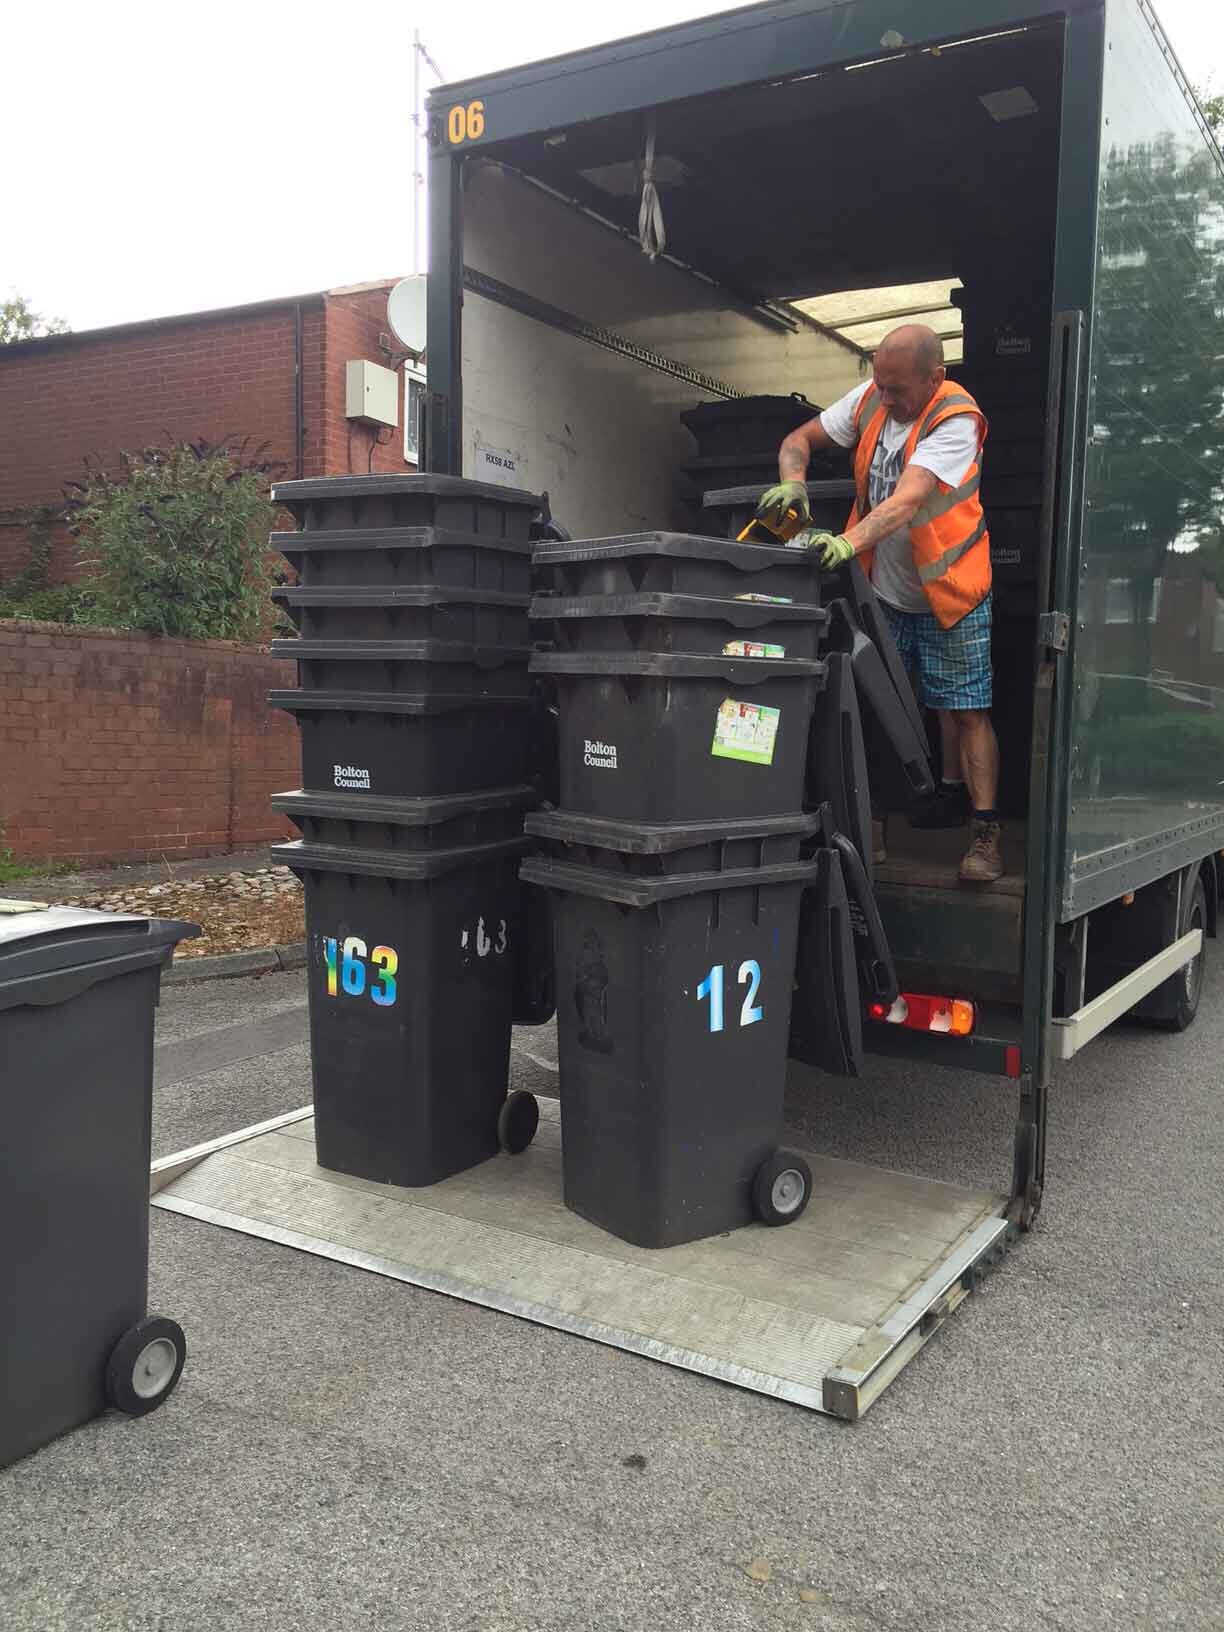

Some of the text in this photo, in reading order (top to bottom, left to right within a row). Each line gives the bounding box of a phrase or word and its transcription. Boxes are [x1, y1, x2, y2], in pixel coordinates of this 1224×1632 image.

[448, 100, 485, 144] 06
[584, 741, 617, 757] Bolton
[584, 754, 618, 769] Council
[334, 765, 370, 778] Bolton
[334, 776, 371, 789] Council
